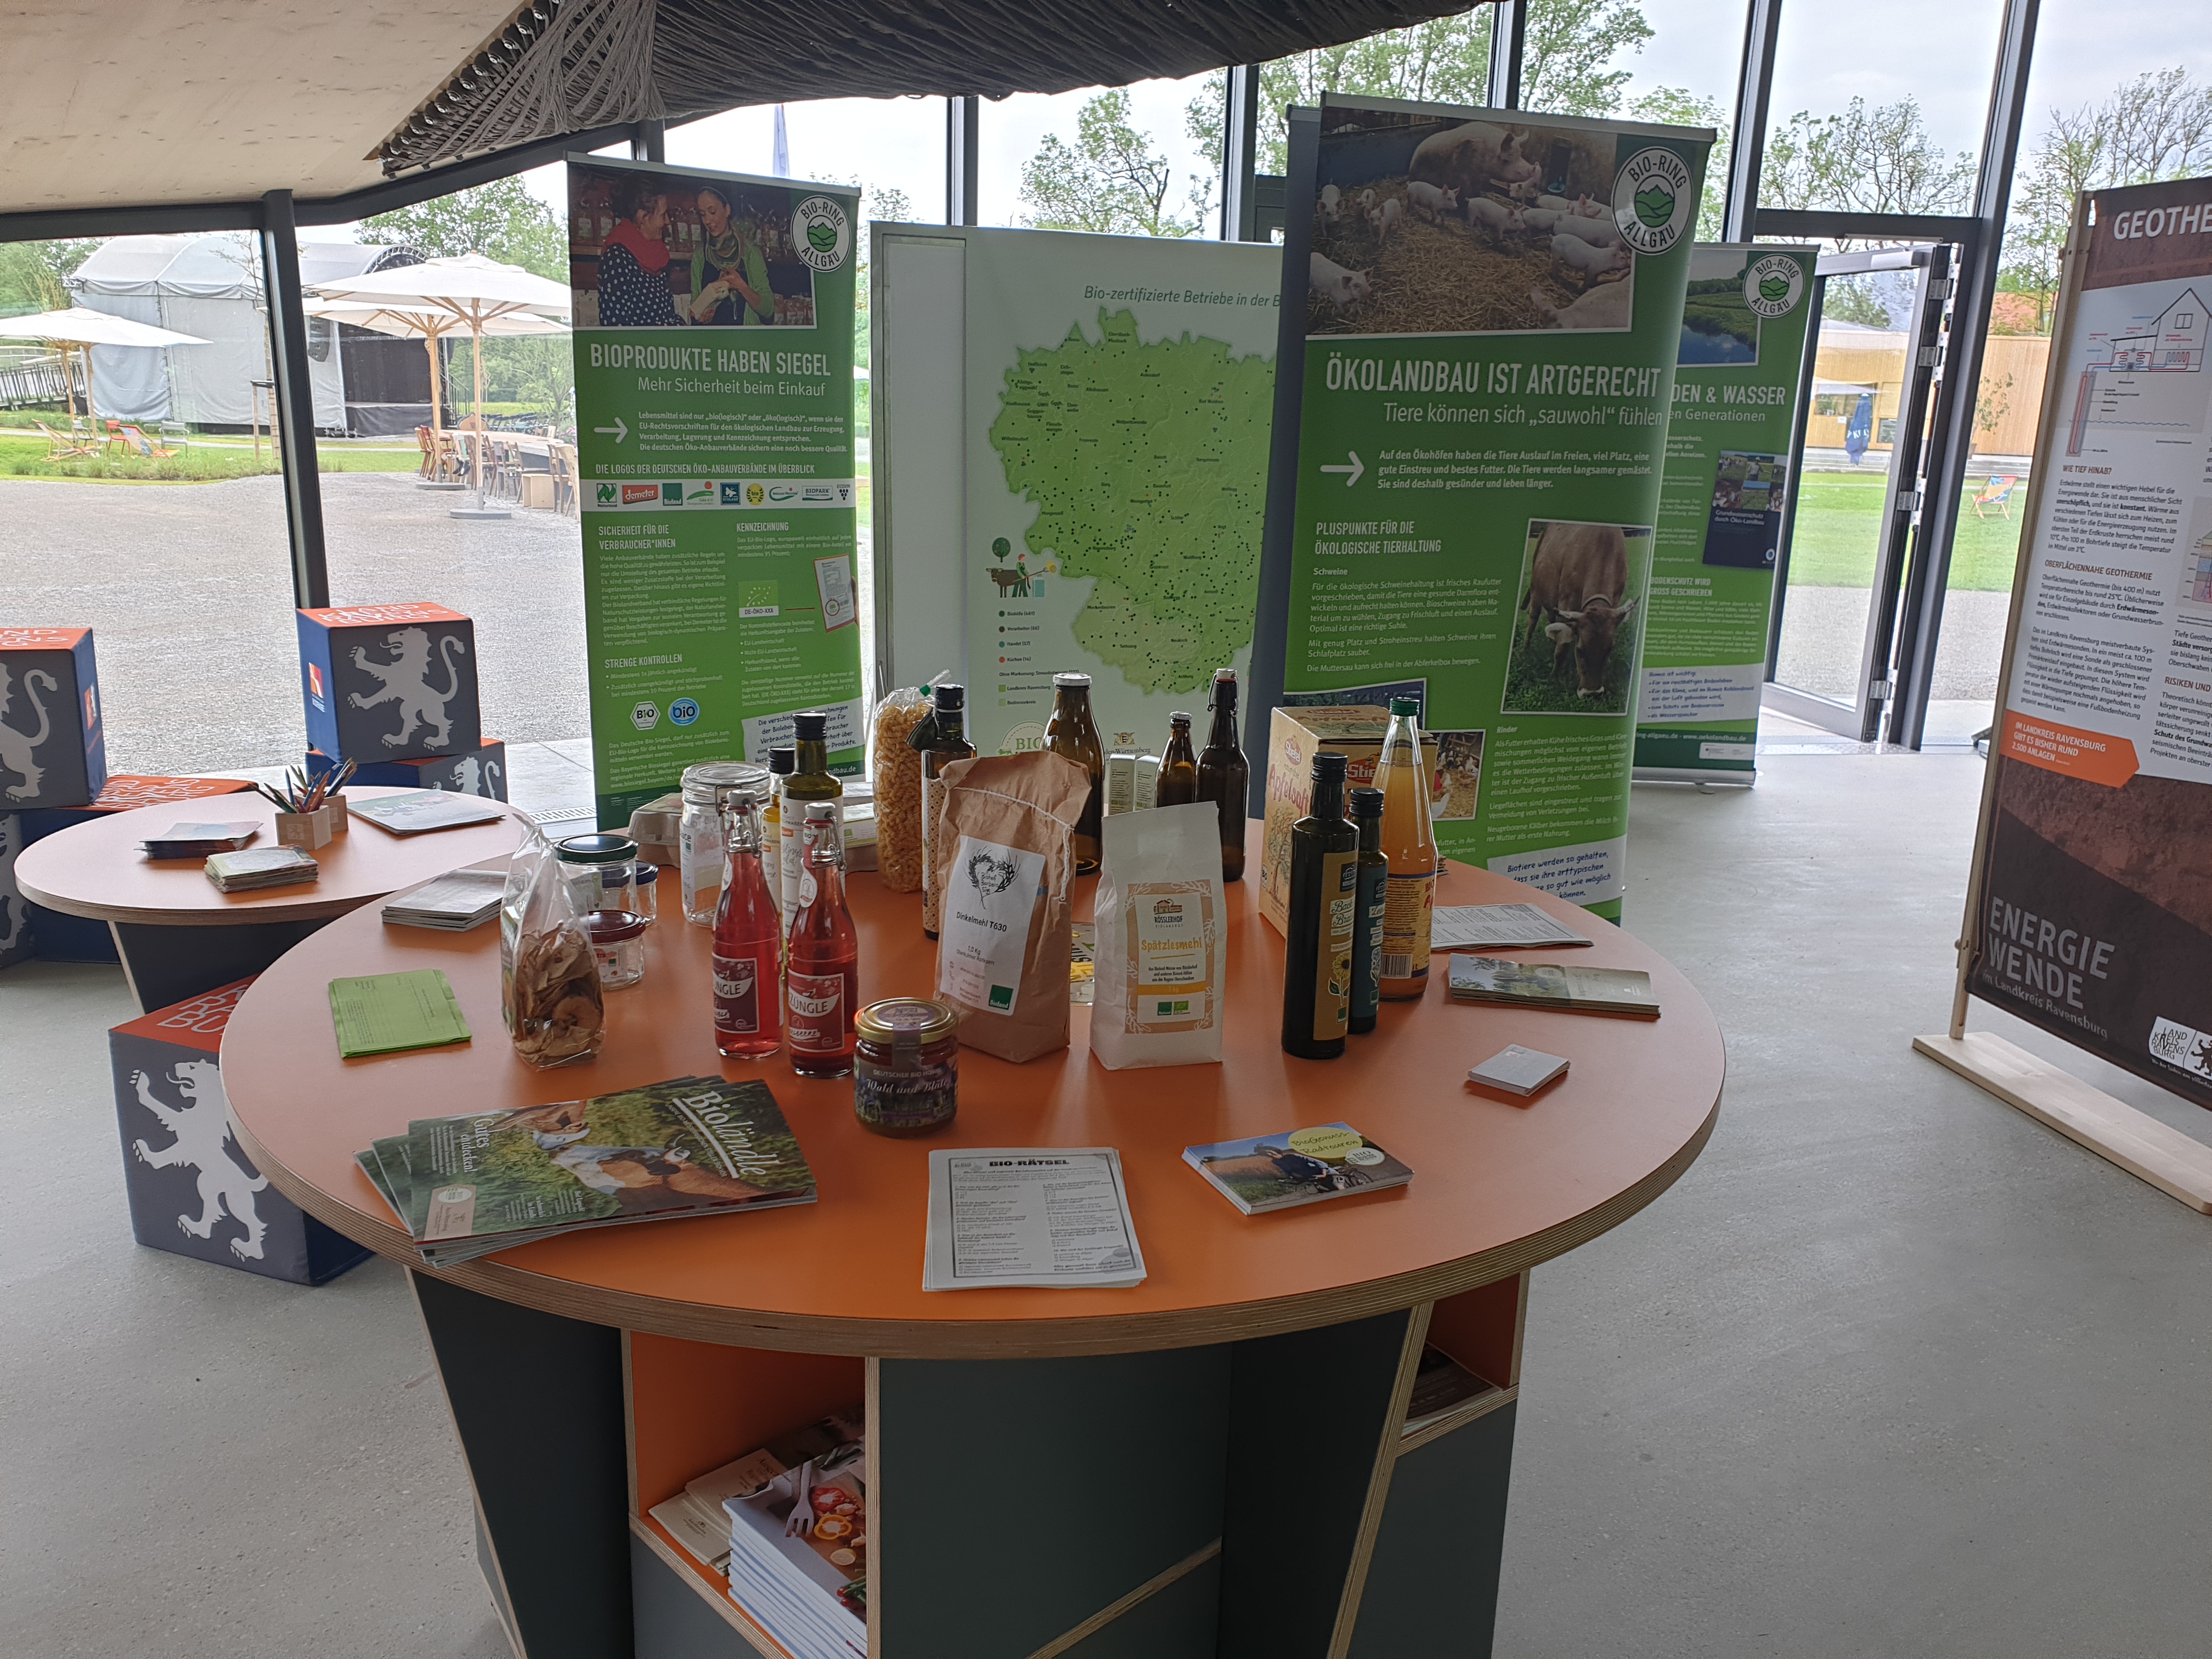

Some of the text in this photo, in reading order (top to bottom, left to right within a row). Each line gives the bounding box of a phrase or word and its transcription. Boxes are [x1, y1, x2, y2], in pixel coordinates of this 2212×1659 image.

[1627, 154, 1686, 189] BIO-RING
[800, 201, 844, 227] BIO-RING
[1623, 220, 1675, 247] ALLGÄU
[802, 247, 840, 267] ALLGÄU
[1756, 258, 1799, 279] BIO-RING
[1085, 286, 1269, 306] Bio-zertifizierte Betriebe in der
[1752, 298, 1790, 313] ALLGÄU
[590, 344, 831, 376] BIOPRODUKTE HABEN SIEGEL
[1327, 352, 1661, 397] ÖKOLANDBAU IST ARTGERECHT
[638, 377, 825, 397] Mehr Sicherheit beim Einkauf
[1672, 385, 1785, 405] DEN & WASSER
[679, 412, 692, 420] sind
[1384, 403, 1662, 426] Tiere können sich „sauwohl“ fühlen
[1685, 409, 1765, 421] Generationen
[639, 422, 708, 431] EU-Rechtsvorschriften
[721, 423, 731, 431] den
[733, 423, 772, 433] ökologischen
[775, 424, 800, 432] Landbau
[1379, 450, 1394, 460] Auf
[1396, 450, 1410, 460] den
[1413, 449, 1453, 460] Ökohöfen
[1455, 450, 1481, 460] haben
[1484, 450, 1497, 460] die
[1499, 450, 1517, 460] Tiere
[1520, 450, 1549, 460] Auslauf
[1551, 450, 1561, 460] im
[1564, 450, 1590, 461] Freien,
[1593, 450, 1607, 460] viel
[1610, 450, 1632, 461] Platz,
[596, 463, 814, 474] DIE LOGOS DER DEUTSCHEN ÖKO-ANBAUVERBÄNDE IM ÜBERBLICK
[1379, 463, 1396, 477] gute
[1399, 463, 1431, 475] Einstreu
[1434, 463, 1449, 475] und
[1452, 463, 1479, 475] bestes
[1481, 464, 1505, 475] Futter.
[1508, 464, 1520, 475] Die
[1522, 464, 1541, 475] Tiere
[1543, 464, 1571, 475] werden
[1573, 464, 1615, 478] langsamer
[625, 489, 654, 499] demeter
[599, 524, 669, 535] SICHERHEIT FÜR DIE
[737, 522, 789, 532] KENNZEICHNUNG
[1316, 520, 1414, 535] PLUSPUNKTE FÜR DIE
[1315, 539, 1441, 555] ÖKOLOGISCHE TIERHALTUNG
[1313, 567, 1347, 576] Schweine
[2045, 558, 2152, 580] OBERFLÄCHENNAHE GEOTHERMIE
[605, 654, 682, 668] STRENGE KONTROLLEN
[2165, 676, 2193, 689] RISIKEN
[2013, 732, 2078, 757] GIBT ES BISHER RUND
[2023, 723, 2055, 740] LANDKREIS
[2056, 733, 2106, 752] RAVENSBURG
[2028, 746, 2055, 761] ANLAGEN
[1268, 763, 1309, 817] Apfelsaft
[1508, 863, 1535, 872] Biotiere
[1538, 859, 1564, 867] werden
[1577, 851, 1609, 864] gehalten,
[1530, 873, 1539, 881] sie
[1558, 864, 1604, 876] arttypischen
[1556, 879, 1568, 891] gut
[1585, 873, 1611, 884] möglich
[1559, 890, 1585, 899] können.
[957, 912, 1007, 932] Dinkelmehl T630
[1142, 937, 1202, 952] Spätzlesmehl
[1989, 896, 2115, 980] ENERGIE
[1988, 934, 2084, 1009] WENDE
[789, 993, 827, 1014] ZÜNGLE
[1983, 969, 2108, 1040] im Landkreis Ravensburg
[873, 1070, 909, 1078] DEUTSCHER
[866, 1079, 894, 1093] Wald
[896, 1084, 918, 1093] und
[473, 1118, 493, 1148] Gutes
[681, 1090, 778, 1177] Bioländle
[1300, 1139, 1358, 1154] Radtouren
